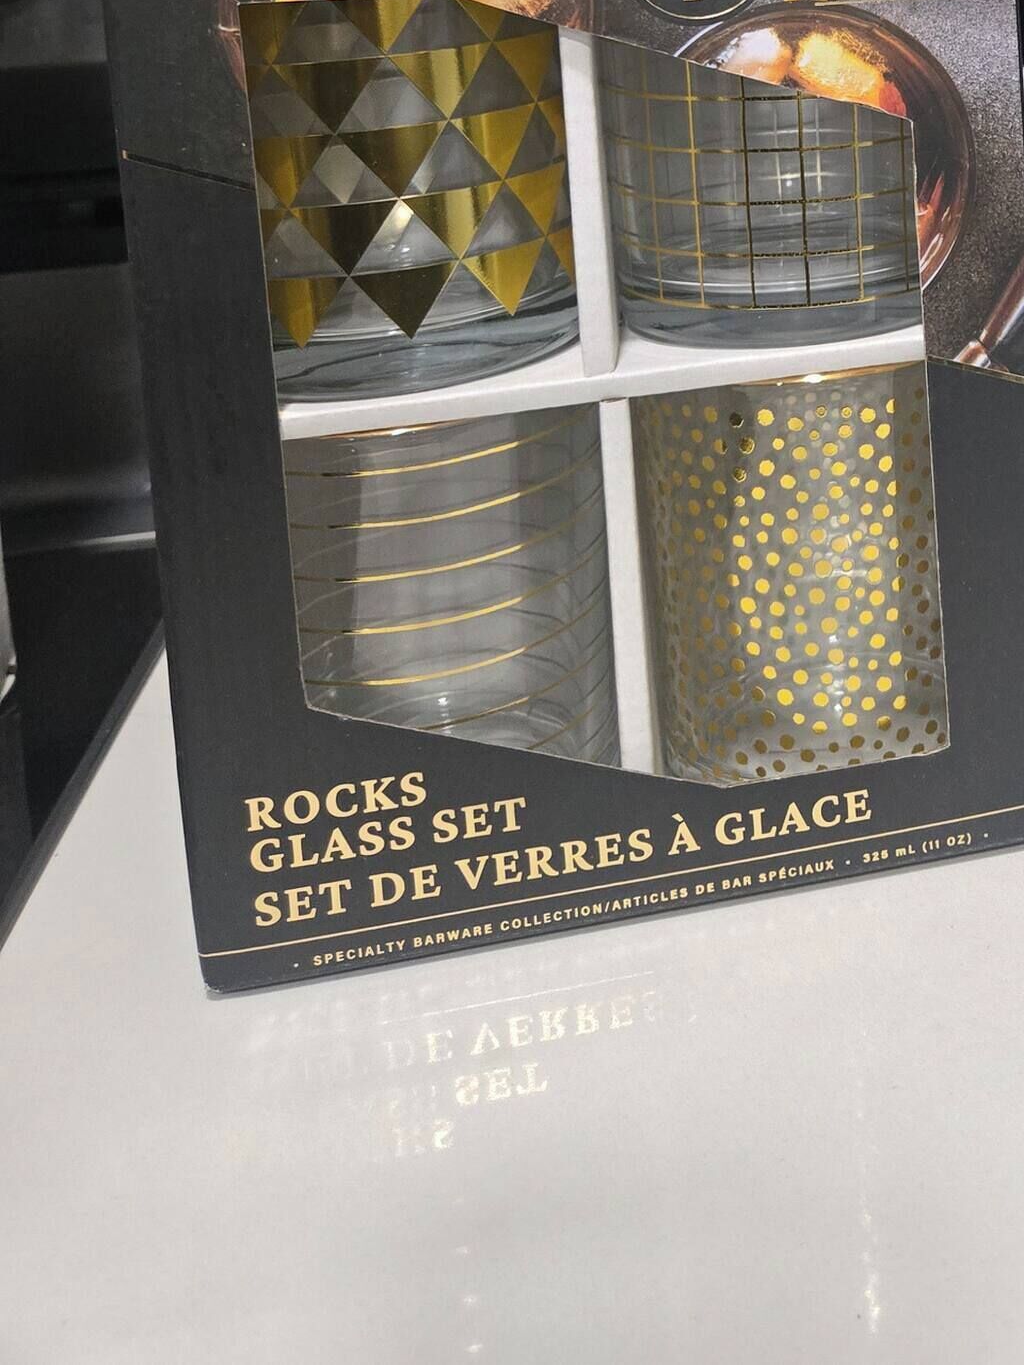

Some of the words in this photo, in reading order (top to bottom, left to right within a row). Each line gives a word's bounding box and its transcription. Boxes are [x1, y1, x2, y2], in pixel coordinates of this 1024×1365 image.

[244, 771, 428, 833] ROCKS
[250, 816, 416, 873] GLASS
[432, 796, 527, 844] SET
[254, 878, 352, 928] SET
[369, 864, 441, 908] DE
[454, 827, 654, 891] VERRES
[668, 814, 700, 856] À
[714, 788, 873, 846] GLACE
[312, 939, 406, 966] SPECIALTY
[413, 923, 494, 948] BARWARE
[695, 882, 716, 896] DE
[722, 875, 753, 891] BAR
[758, 859, 835, 884] SPÉCIAUX
[862, 848, 890, 864] 325
[895, 844, 917, 858] mL
[921, 838, 941, 856] (11
[946, 832, 973, 848] OZ)
